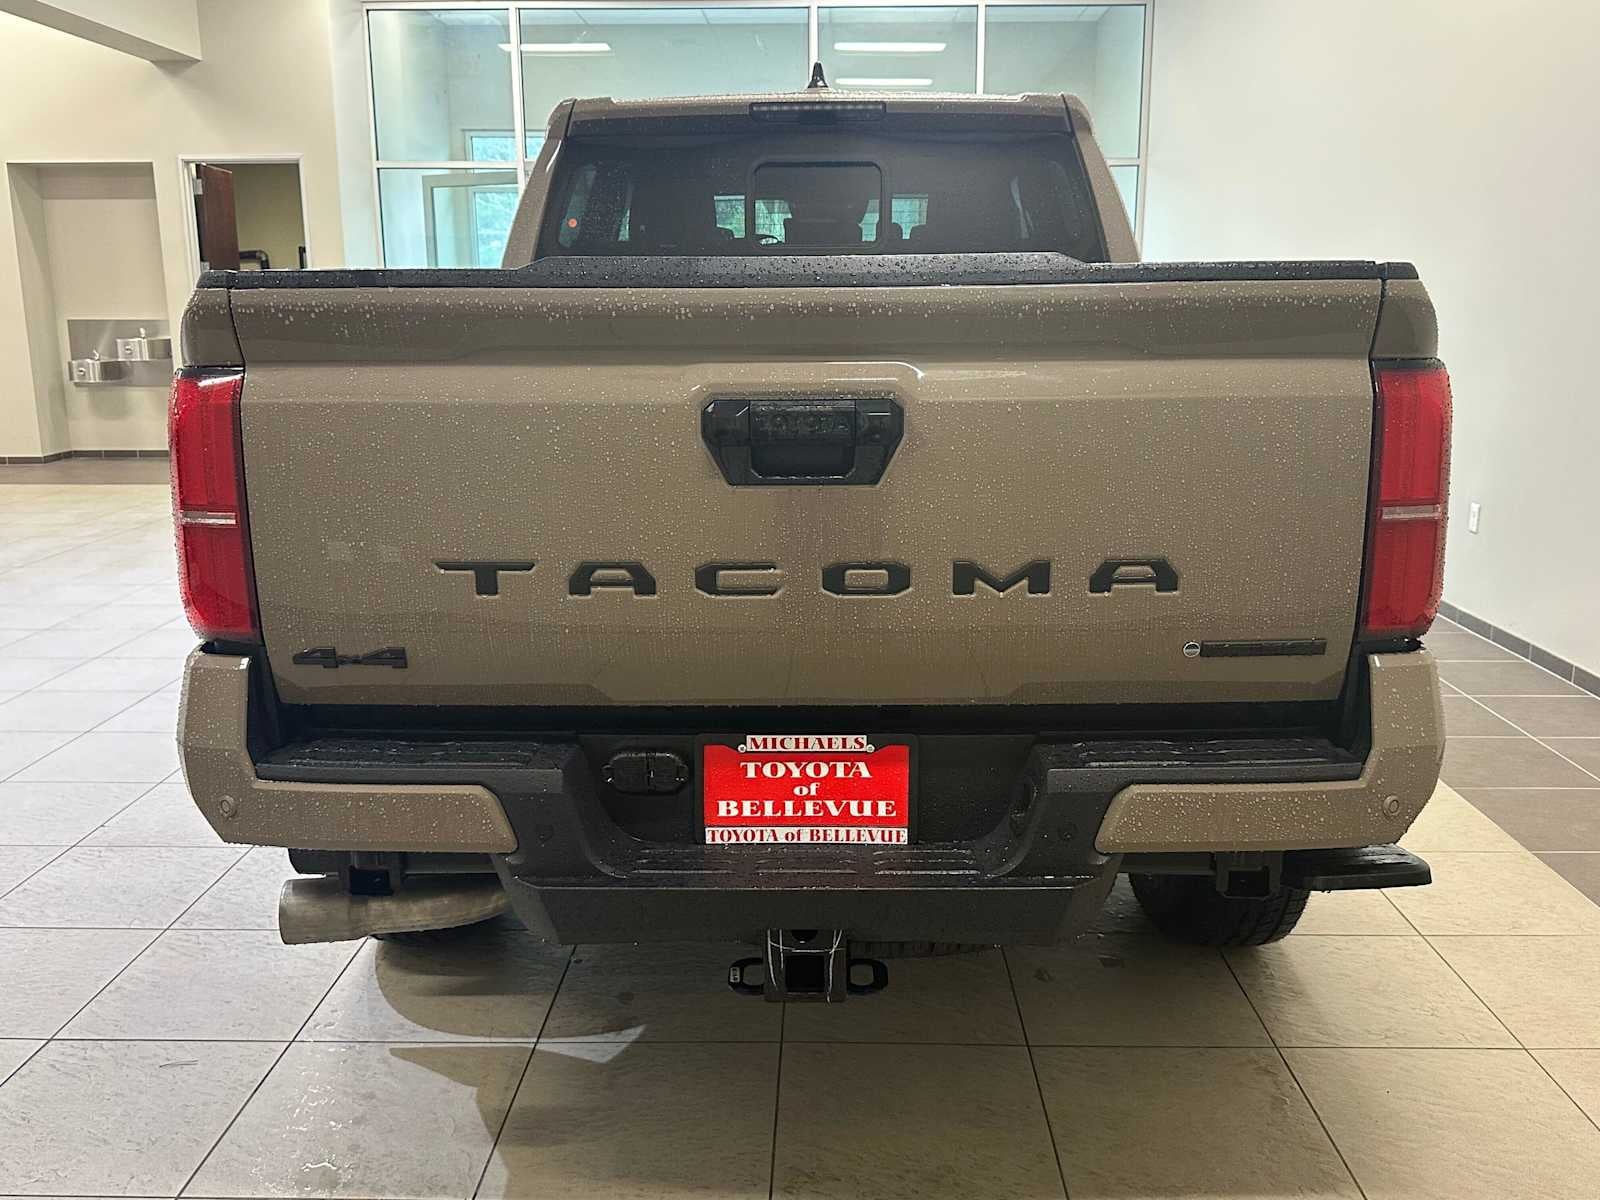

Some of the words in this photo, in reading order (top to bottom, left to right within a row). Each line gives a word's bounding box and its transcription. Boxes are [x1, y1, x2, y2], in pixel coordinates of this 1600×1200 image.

[433, 560, 1178, 597] TACOMA
[749, 736, 866, 750] MICHAELS
[740, 761, 873, 779] TOYOTA
[793, 782, 821, 796] of
[716, 800, 897, 817] BELLEVUE
[708, 829, 779, 843] TOYOTA
[784, 828, 803, 842] of
[809, 829, 907, 844] BELLEVUE
